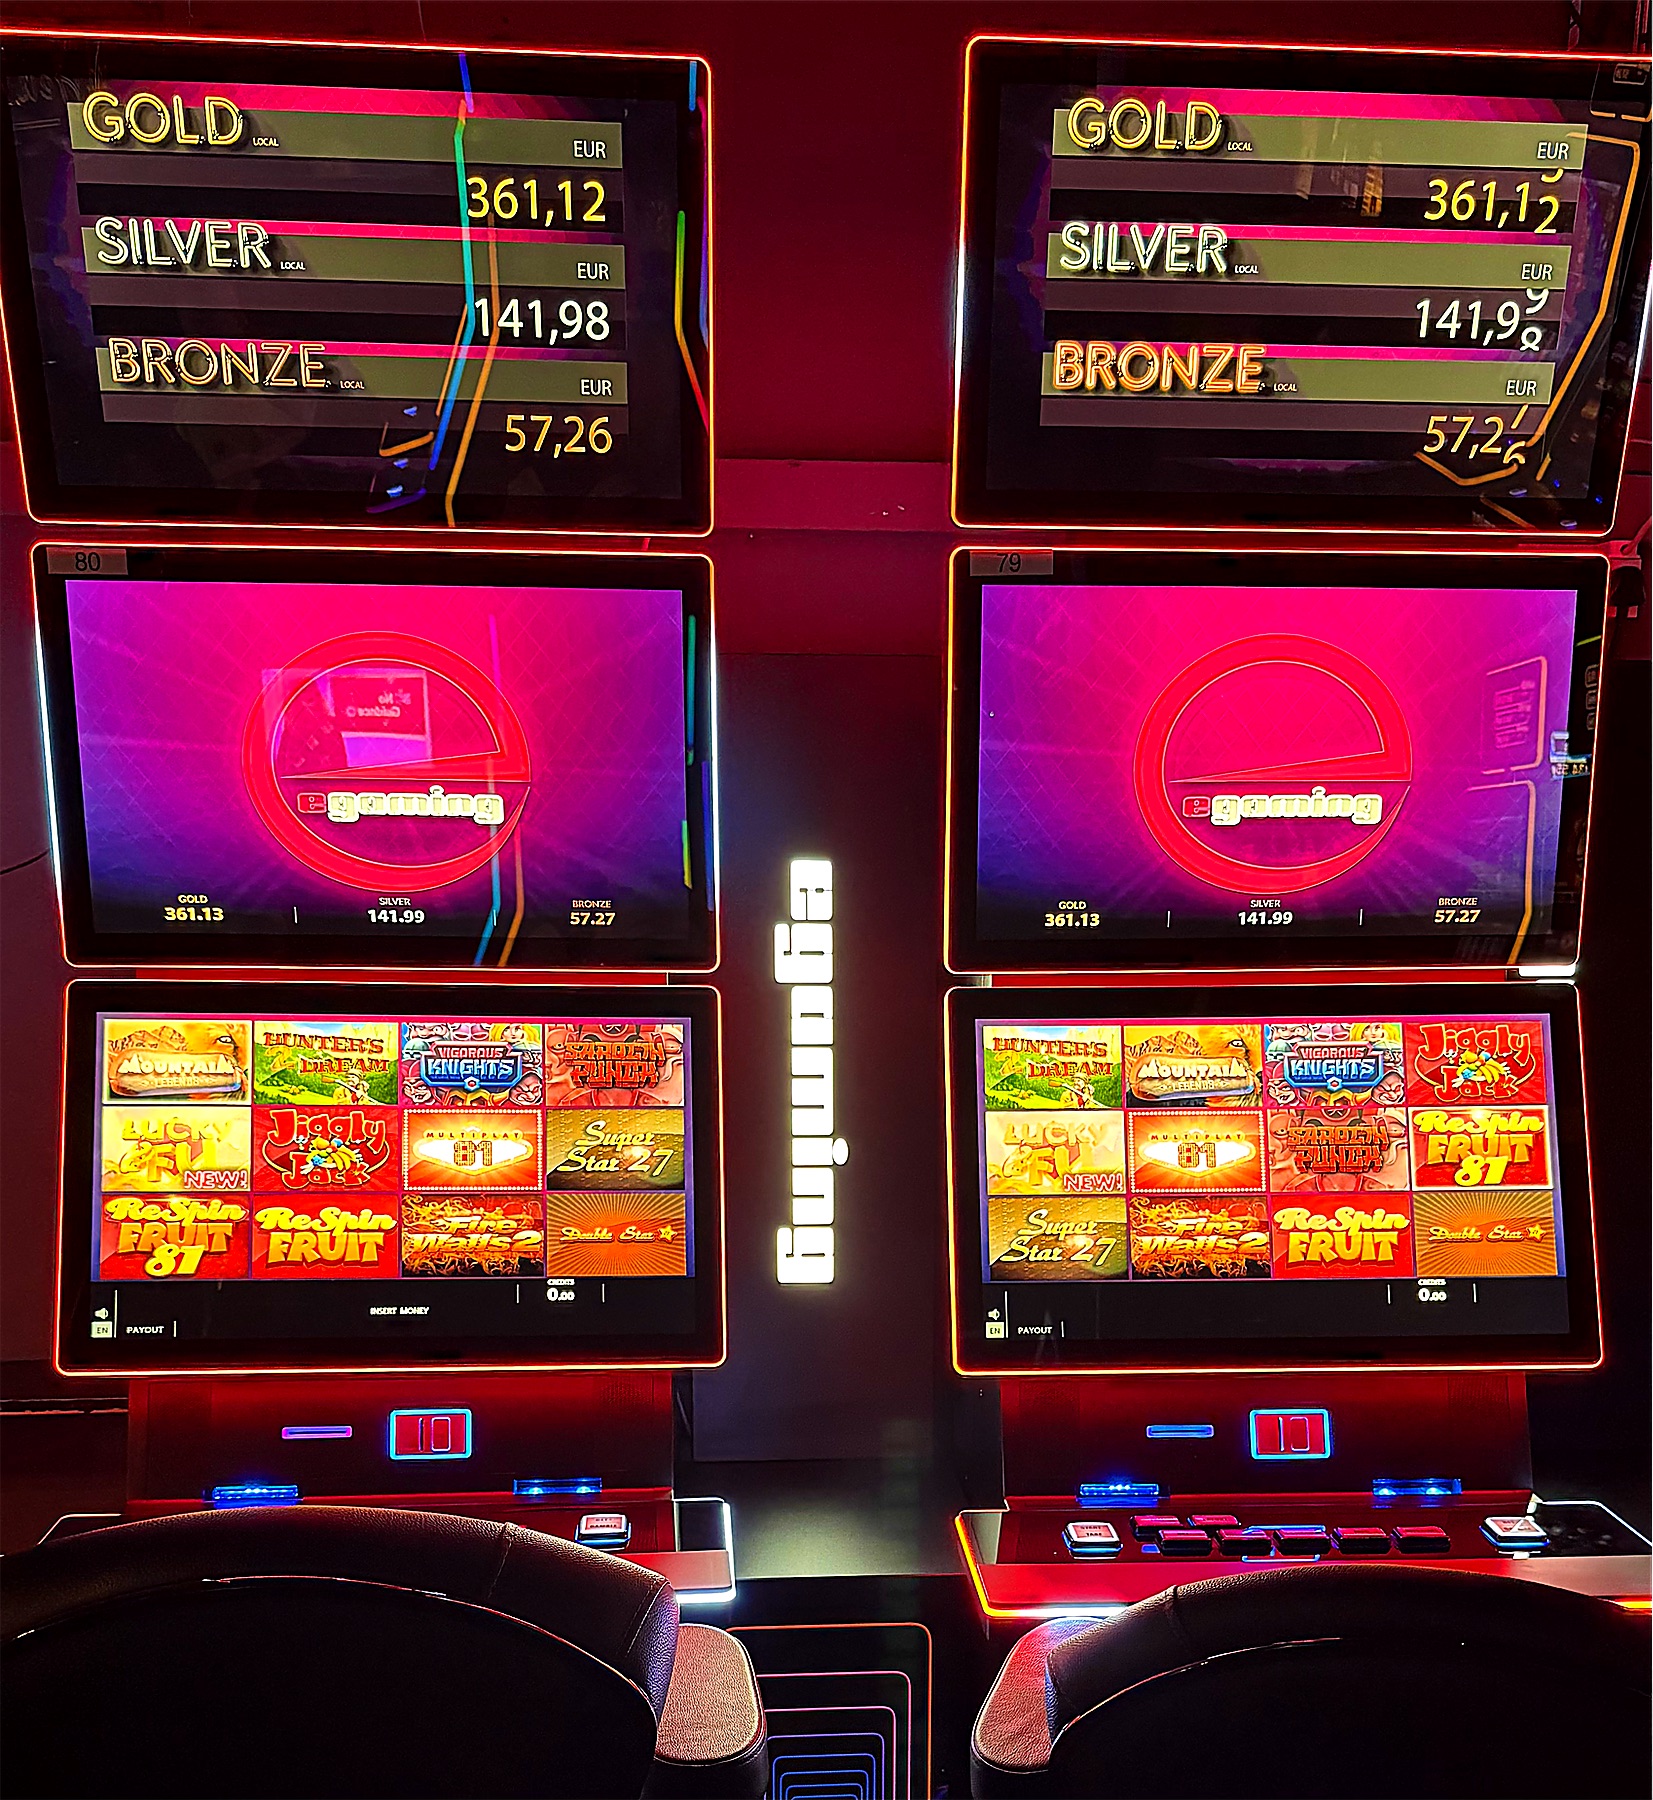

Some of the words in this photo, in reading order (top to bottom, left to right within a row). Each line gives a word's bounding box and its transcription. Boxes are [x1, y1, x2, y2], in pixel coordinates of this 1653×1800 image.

[82, 91, 244, 147] GOLD
[252, 136, 280, 148] LOCAL
[1067, 97, 1223, 152] GOLD
[1227, 141, 1253, 153] LOCAL
[572, 140, 607, 159] EUR
[1536, 142, 1570, 161] EUR
[466, 177, 607, 227] 361,12
[94, 216, 272, 269] SILVER
[280, 260, 306, 271] LOCAL
[1059, 222, 1228, 275] SILVER
[1234, 264, 1260, 275] LOCAL
[576, 262, 610, 281] EUR
[1521, 264, 1553, 281] EUR
[475, 298, 610, 346] 141,98
[107, 337, 331, 389] BRONZE
[339, 379, 365, 390] LOCAL
[1052, 340, 1268, 393] BRONZE
[1273, 381, 1298, 392] LOCAL
[579, 378, 612, 397] EUR
[1506, 380, 1537, 396] EUR
[504, 415, 613, 460] 57,26
[75, 552, 101, 571] 80
[997, 552, 1021, 572] 79
[177, 894, 209, 905] GOLD
[378, 897, 412, 907] SILVER
[571, 899, 612, 910] BRONZE
[1058, 900, 1087, 910] GOLD
[1250, 899, 1282, 909] SILVER
[1437, 897, 1478, 907] BRONZE
[164, 906, 225, 923] 361.13
[367, 908, 425, 925] 141.99
[569, 911, 617, 927] 57.27
[1044, 912, 1101, 928] 361.13
[1237, 909, 1293, 926] 141.99
[1433, 908, 1481, 925] 57.27
[263, 1032, 385, 1055] HUNTER'S
[437, 1047, 504, 1059] VIGOROUS
[992, 1037, 1108, 1059] HUNTER'S
[1300, 1046, 1365, 1058] VIGOROUS
[1418, 1024, 1531, 1066] Jiggly
[118, 1053, 235, 1075] MOUNTAIN
[265, 1046, 295, 1071] 2
[298, 1057, 390, 1075] DREAM
[427, 1058, 515, 1077] KNIGHTS
[994, 1051, 1023, 1076] 2
[1027, 1060, 1114, 1079] DREAM
[1137, 1056, 1249, 1078] MOUNTAIN
[1291, 1059, 1375, 1077] KNIGHTS
[773, 859, 850, 1285] egaming
[1434, 1066, 1519, 1102] Jack
[122, 1117, 231, 1142] LUCKY
[268, 1109, 386, 1154] Jiggly
[426, 1131, 520, 1139] MULTIPLAY
[1004, 1121, 1108, 1146] LUCKY
[1414, 1111, 1544, 1138] ReSpin
[576, 1120, 657, 1152] Super
[1151, 1133, 1243, 1141] MULTIPLAY
[453, 1141, 492, 1167] 81
[1178, 1143, 1217, 1168] 81
[1427, 1133, 1533, 1165] FRUIT
[282, 1151, 371, 1189] Jack
[557, 1147, 620, 1172] Star
[625, 1149, 675, 1177] 27
[183, 1169, 248, 1190] NEW!
[1063, 1173, 1124, 1193] NEW!
[105, 1197, 249, 1226] ReSpin
[254, 1206, 398, 1236] ReSpin
[1274, 1206, 1409, 1236] ReSpin
[442, 1216, 518, 1234] Fire
[560, 1226, 614, 1241] Double
[619, 1225, 655, 1241] Star
[1018, 1208, 1098, 1240] Super
[1171, 1218, 1244, 1236] Fire
[1428, 1226, 1482, 1241] Double
[1487, 1224, 1524, 1241] Star
[118, 1222, 233, 1254] FRUIT
[267, 1232, 385, 1264] FRUIT
[1288, 1231, 1399, 1263] FRUIT
[1000, 1236, 1062, 1262] Star
[1070, 1237, 1117, 1266] 27
[370, 1306, 397, 1315] INSERT
[96, 1326, 109, 1335] EN
[126, 1325, 165, 1335] PAYOUT
[989, 1326, 1001, 1335] EN
[1017, 1326, 1053, 1335] PAYOUT
